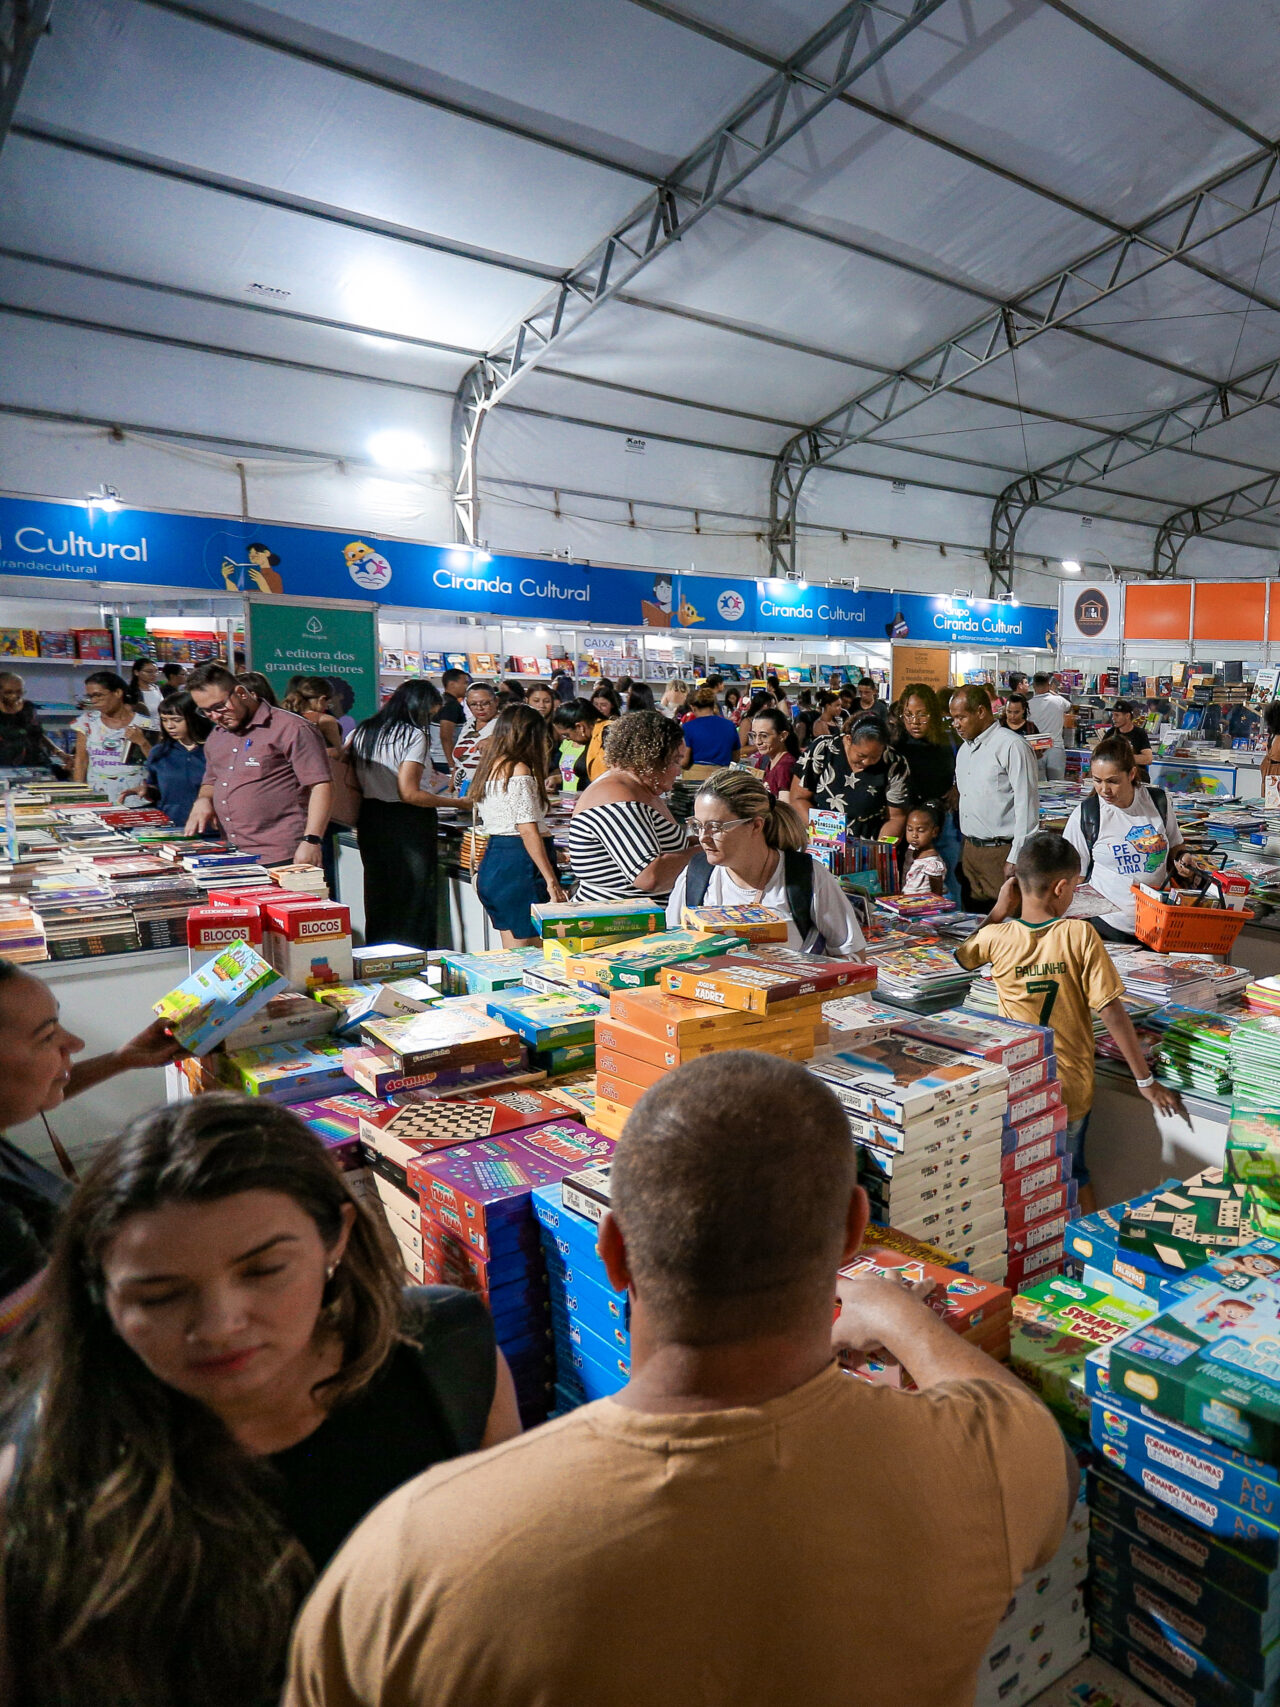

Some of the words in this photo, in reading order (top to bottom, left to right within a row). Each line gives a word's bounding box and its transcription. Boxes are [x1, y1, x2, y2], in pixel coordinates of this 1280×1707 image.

[248, 282, 291, 296] Kato
[627, 437, 646, 447] Kato
[15, 527, 148, 562] Cultural
[432, 569, 513, 595] Ciranda
[519, 578, 590, 602] Cultural
[760, 600, 813, 619] Ciranda
[817, 604, 866, 622] Cultural
[944, 602, 970, 617] Grupo
[933, 614, 979, 632] Ciranda
[981, 617, 1023, 635] Cultural
[584, 638, 615, 650] CAIXA
[274, 648, 283, 658] A
[286, 649, 331, 660] editora
[335, 652, 355, 661] dos
[265, 662, 316, 673] grandes
[319, 663, 364, 674] leitores
[1112, 844, 1130, 857] PE
[1115, 854, 1141, 867] TRO
[1117, 864, 1142, 876] LINA
[301, 920, 340, 934] BLOCOS
[203, 929, 248, 942] BLOCOS
[1015, 962, 1067, 978] PAULINHO
[694, 988, 725, 1003] XADREZ
[1026, 980, 1060, 1027] 7
[1227, 1273, 1250, 1287] 28
[1061, 1305, 1130, 1337] LAVRAS
[1146, 1435, 1184, 1460] FORMANDO
[1186, 1452, 1222, 1479] PALAVRAS
[1143, 1471, 1180, 1497] FORMANDO
[1181, 1489, 1216, 1516] PALAVRAS
